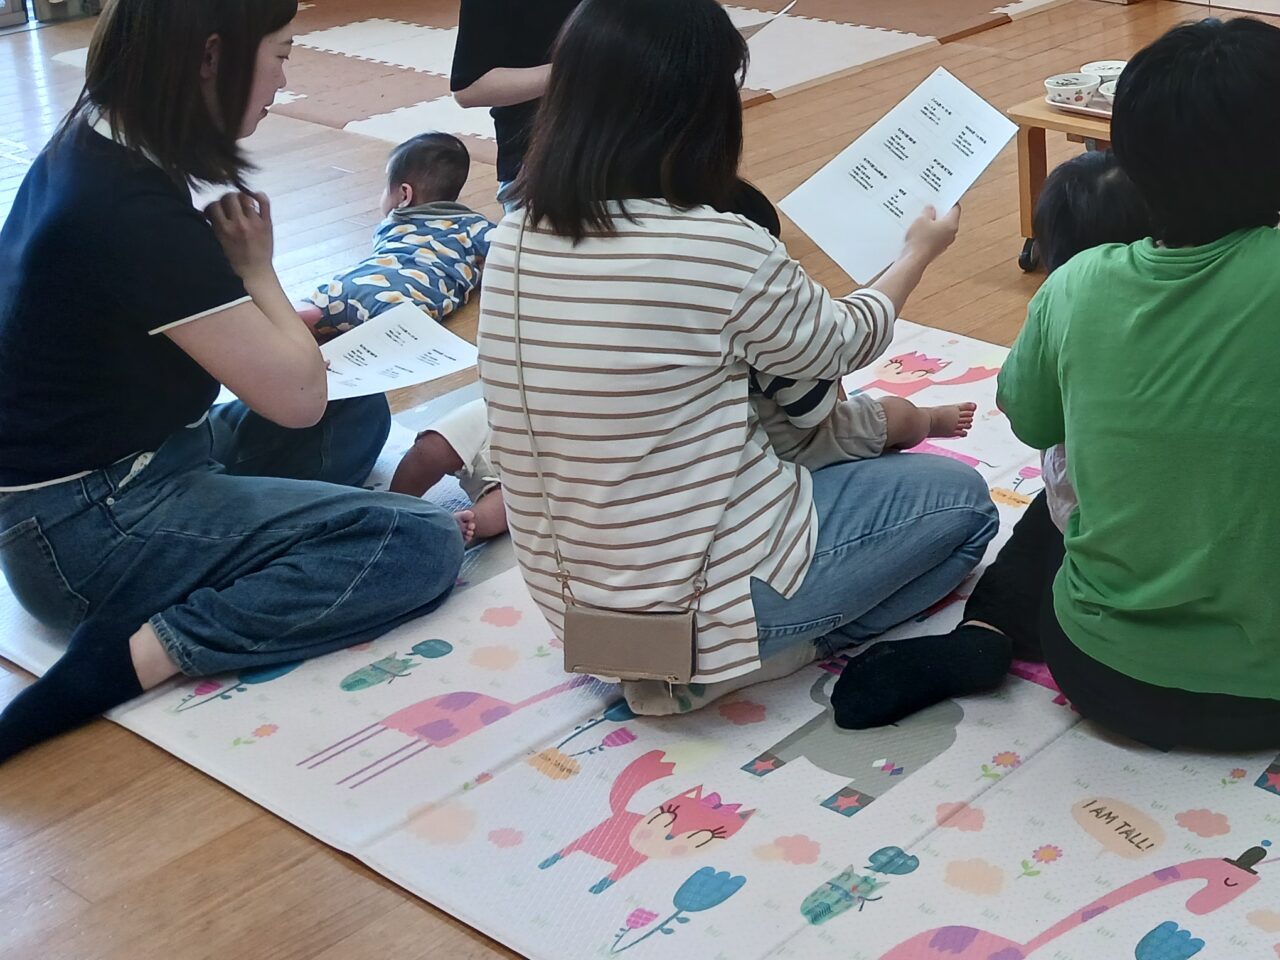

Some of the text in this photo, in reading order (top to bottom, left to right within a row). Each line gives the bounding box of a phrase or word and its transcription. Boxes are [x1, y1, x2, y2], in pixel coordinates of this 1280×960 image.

[1082, 799, 1155, 853] I AM TALL!
